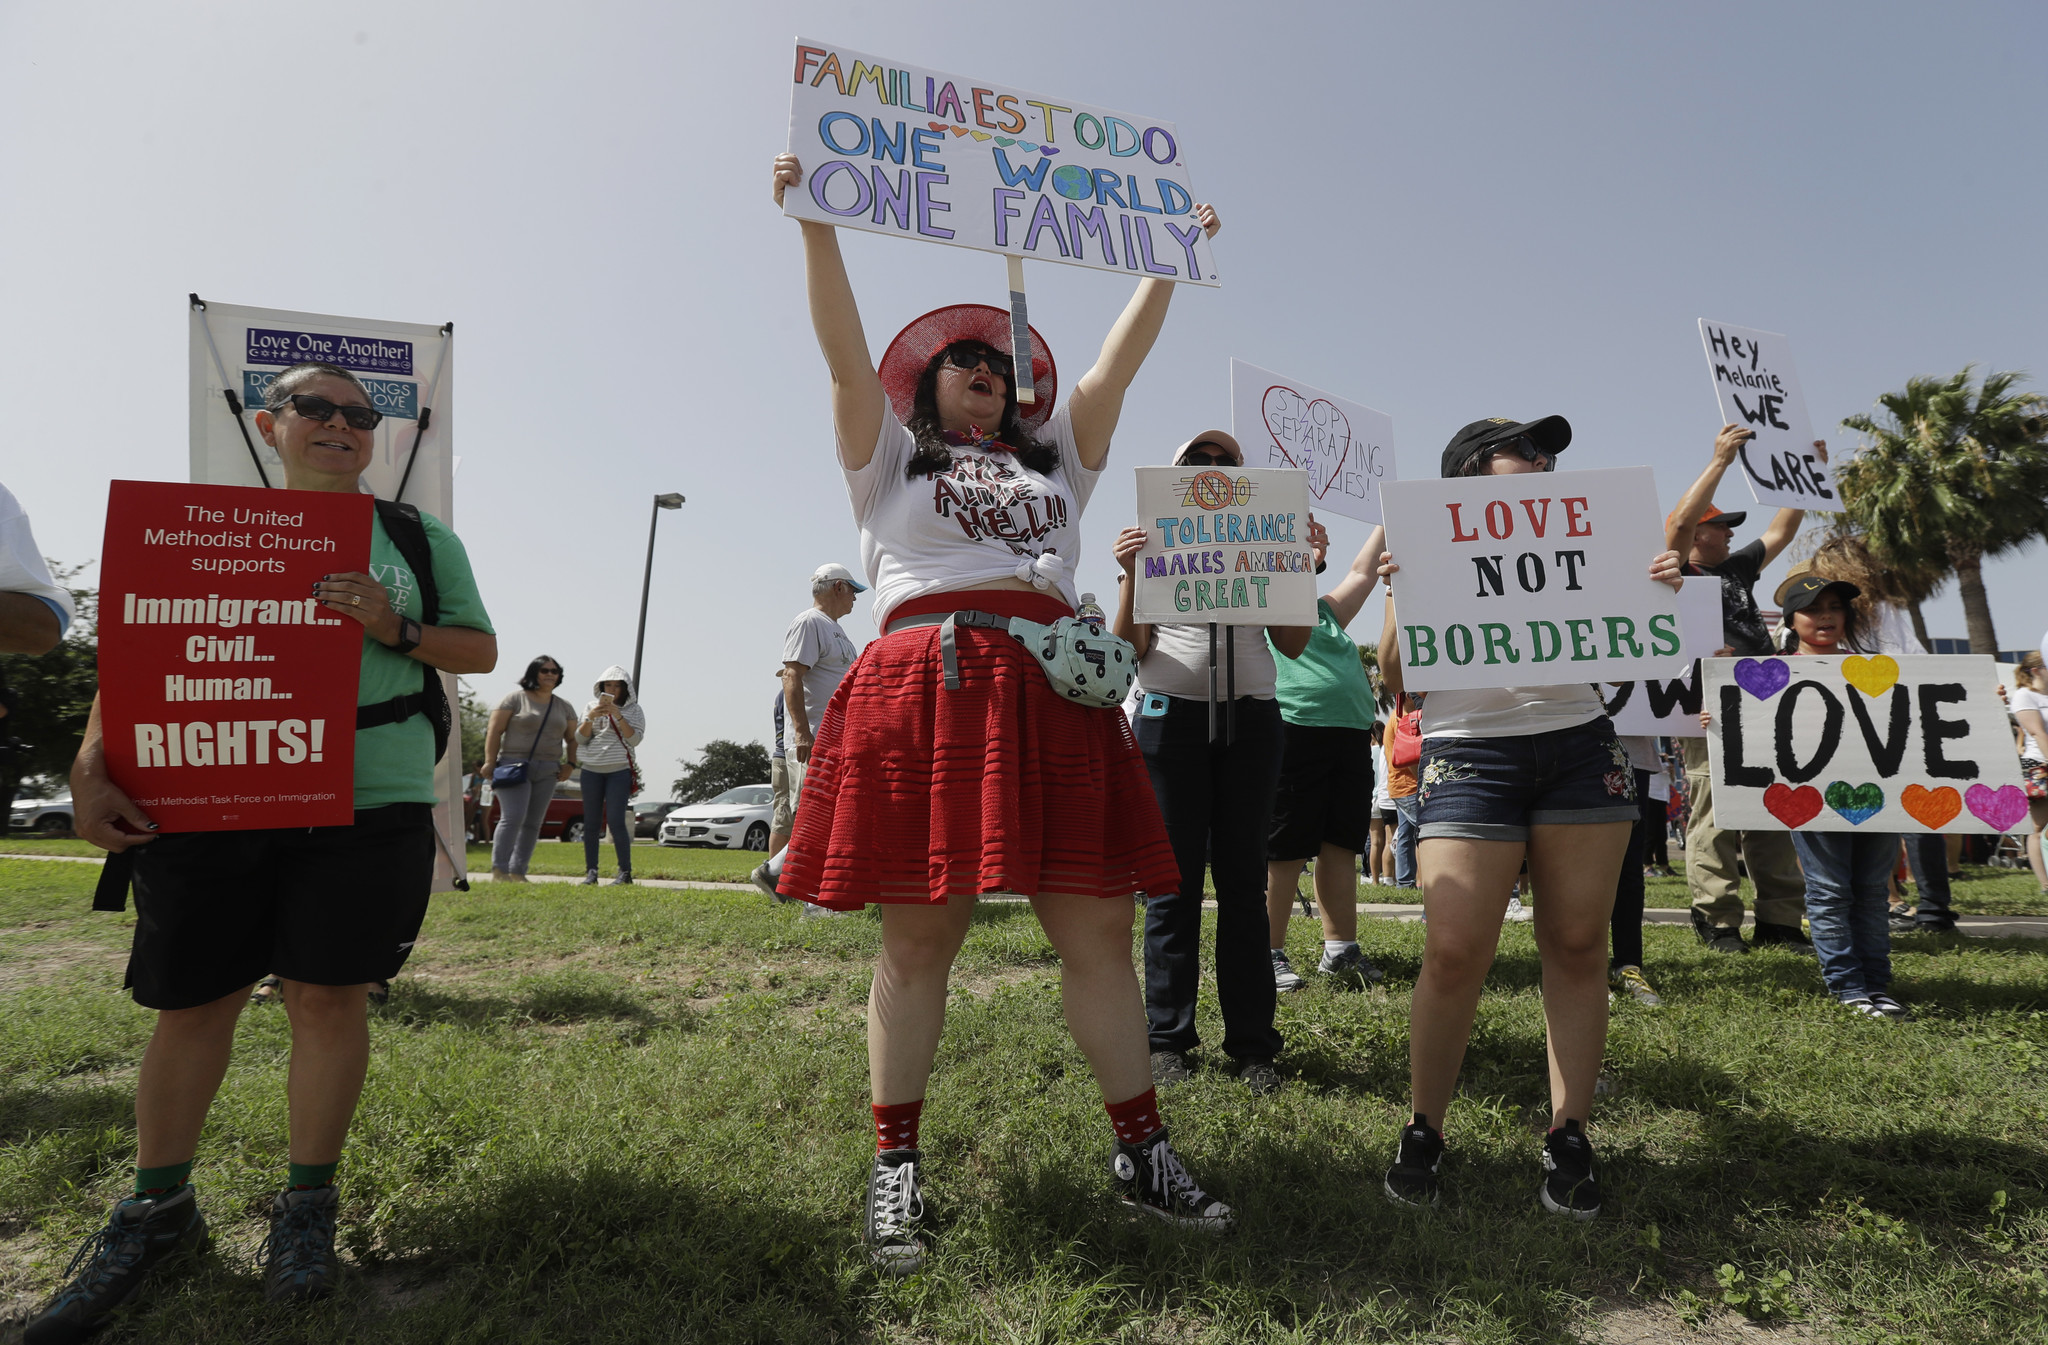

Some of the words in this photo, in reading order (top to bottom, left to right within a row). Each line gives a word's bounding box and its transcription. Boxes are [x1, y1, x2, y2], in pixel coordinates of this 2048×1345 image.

[818, 111, 945, 172] ONE
[809, 161, 955, 239] ONE
[993, 188, 1216, 280] FAMILY.
[250, 330, 290, 349] Love
[296, 334, 333, 353] One
[338, 337, 409, 360] Another!
[1708, 325, 1759, 371] Hey
[370, 393, 406, 408] OVE
[1276, 390, 1340, 428] STOP
[1732, 393, 1790, 431] WE
[1271, 413, 1383, 477] SEPARATING
[1738, 431, 1833, 500] CARE
[184, 505, 225, 523] The
[233, 507, 304, 527] United
[1156, 513, 1296, 547] TOLERANCE
[1445, 497, 1593, 542] LOVE
[144, 528, 252, 549] Methodist
[259, 532, 336, 552] Church
[191, 557, 286, 575] supports
[1145, 550, 1225, 578] MAKES
[1235, 551, 1312, 573] AMERICA
[1471, 550, 1586, 597] NOT
[123, 593, 342, 628] Immigrant...
[1174, 576, 1270, 612] GREAT
[186, 635, 275, 663] Civil...
[1404, 614, 1681, 667] BORDERS
[165, 674, 292, 702] Human...
[134, 719, 325, 768] RIGHTS!
[1720, 680, 1980, 788] LOVE
[132, 797, 159, 807] nited
[161, 796, 208, 807] Methodist
[210, 795, 232, 804] Task
[234, 794, 261, 804] Force
[263, 795, 276, 803] on
[278, 791, 336, 803] Immigration
